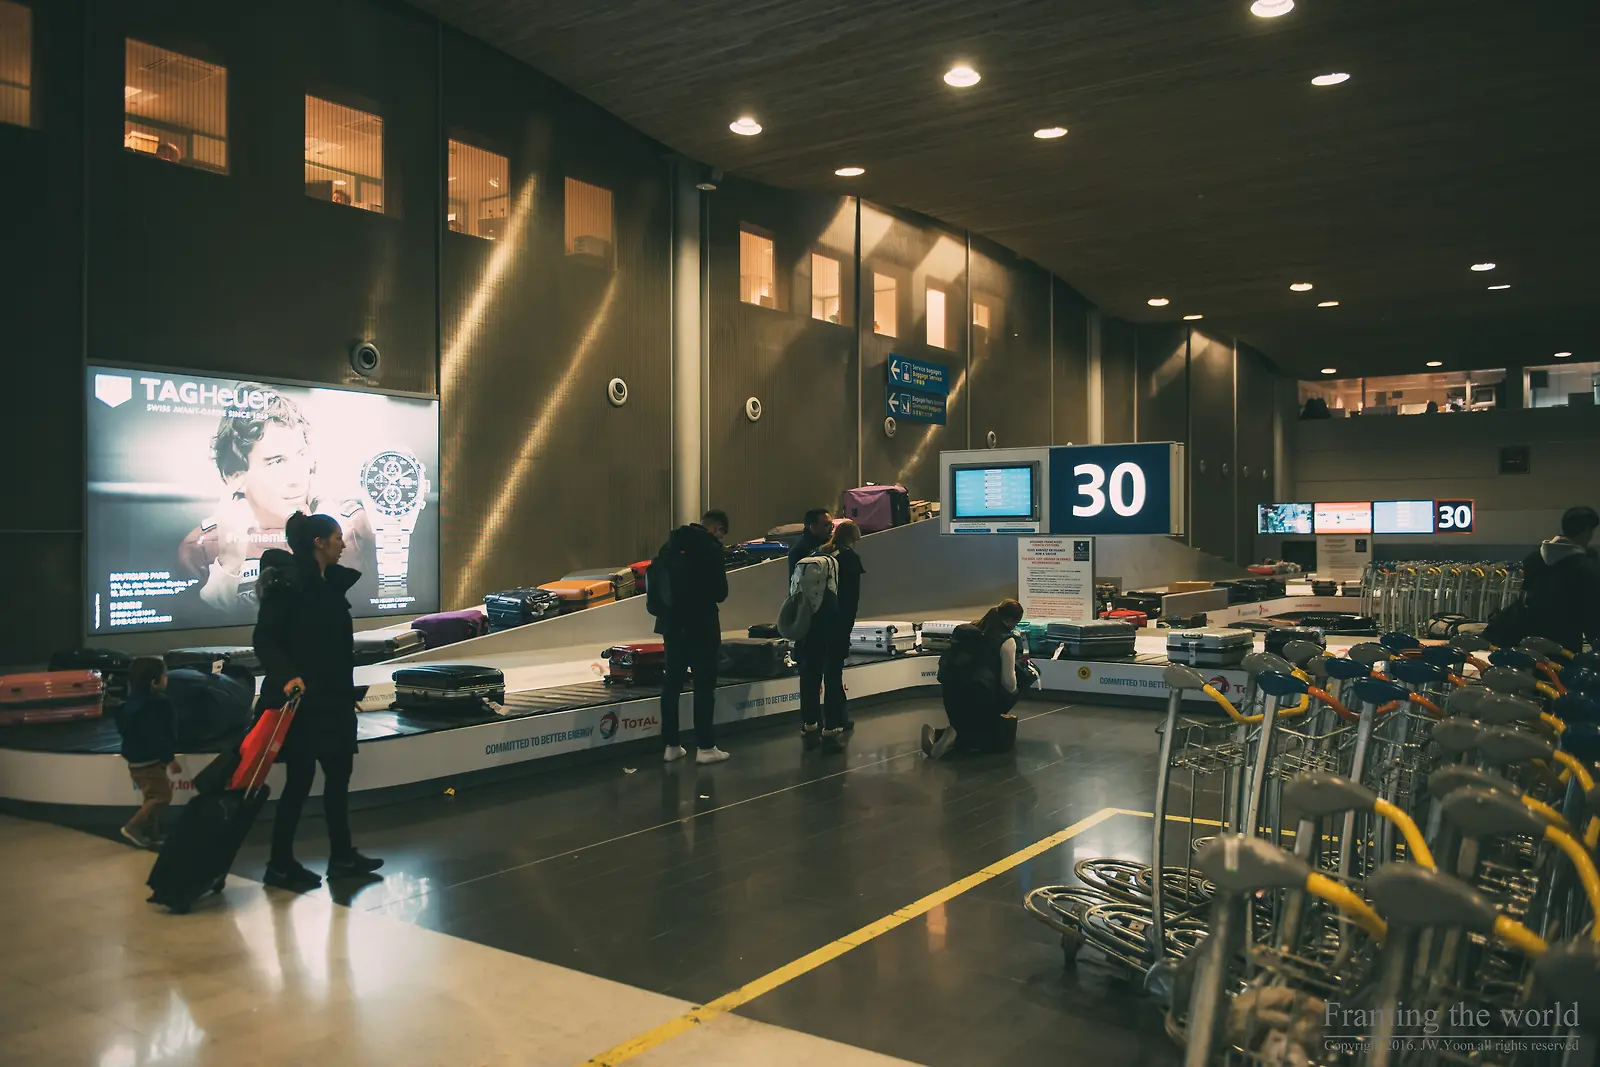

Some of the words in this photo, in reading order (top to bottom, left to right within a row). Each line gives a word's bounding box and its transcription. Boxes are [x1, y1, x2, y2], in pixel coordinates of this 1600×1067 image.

[146, 404, 171, 412] SWISS
[228, 410, 250, 418] SINCE
[1072, 462, 1146, 517] 30
[1438, 505, 1471, 529] 30
[1099, 677, 1138, 687] COMMITTED
[1139, 680, 1147, 688] TO
[736, 698, 765, 711] COMMITTED
[765, 696, 772, 706] TO
[772, 694, 788, 704] BETTER
[485, 739, 530, 755] COMMITTED
[530, 737, 540, 746] TO
[541, 731, 567, 745] BETTER
[568, 726, 594, 740] ENERGY
[622, 716, 658, 730] TOTAL
